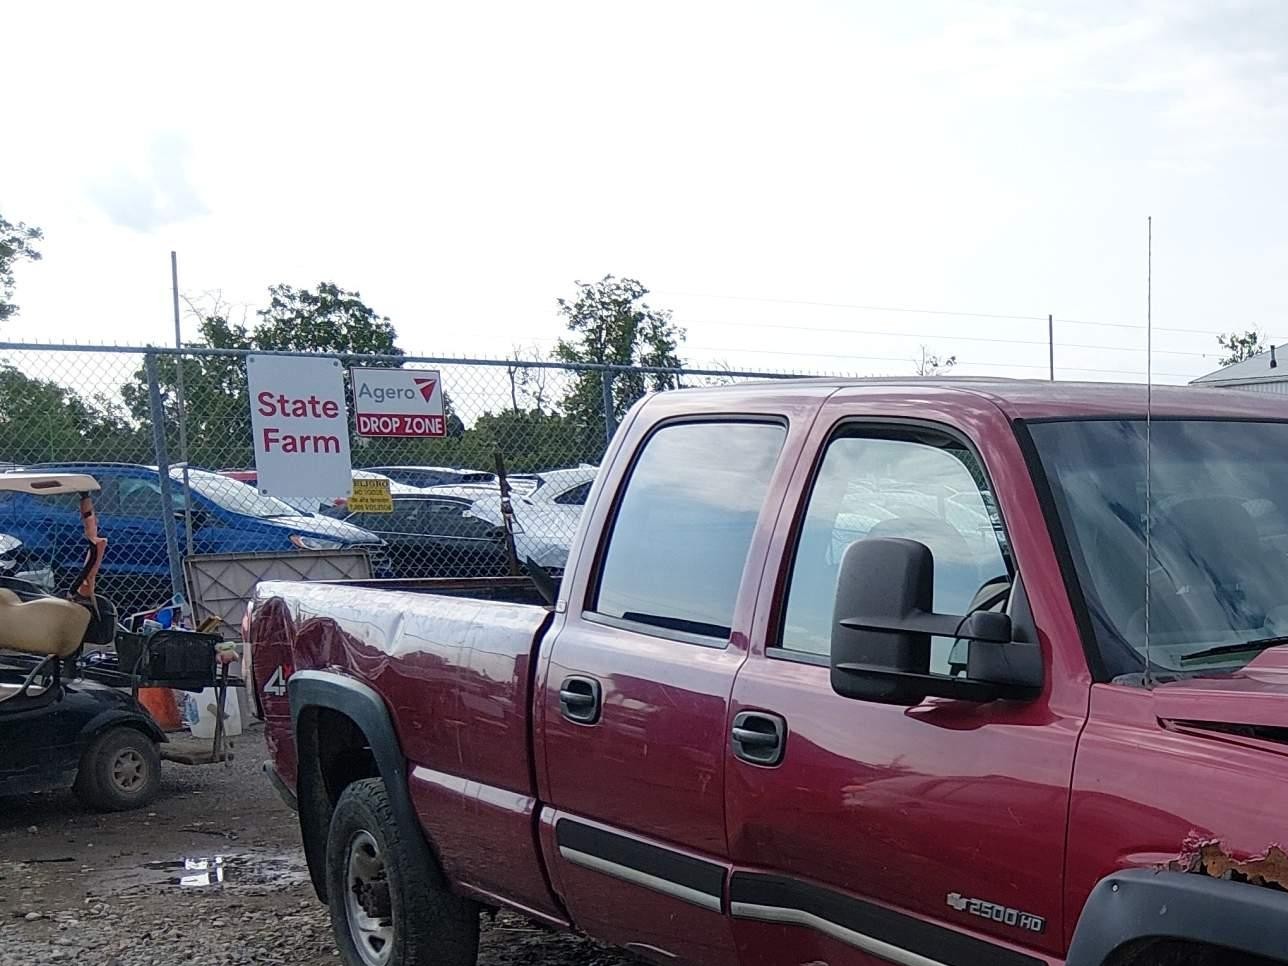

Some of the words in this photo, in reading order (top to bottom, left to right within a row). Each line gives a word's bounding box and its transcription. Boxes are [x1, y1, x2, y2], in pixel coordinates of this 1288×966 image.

[258, 392, 339, 418] State
[358, 383, 415, 403] Agero
[359, 416, 401, 433] DROP
[404, 417, 443, 434] ZONE
[263, 428, 340, 454] Farm
[969, 898, 1019, 926] 2500
[1020, 914, 1042, 931] HD
